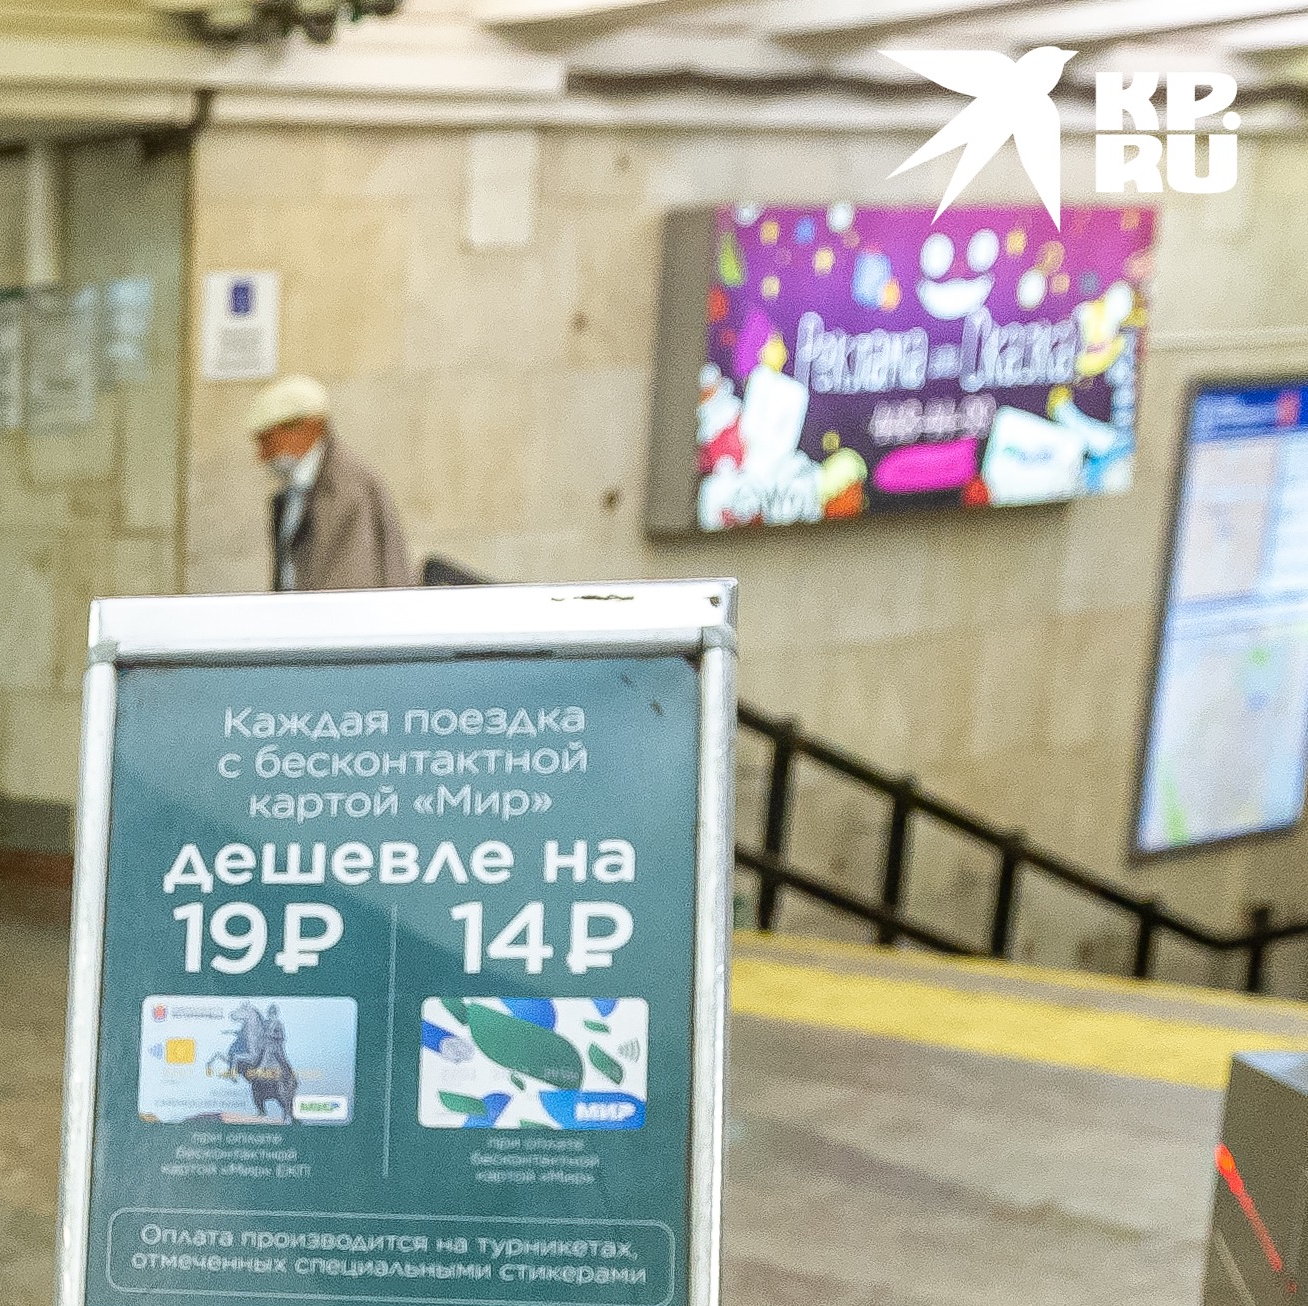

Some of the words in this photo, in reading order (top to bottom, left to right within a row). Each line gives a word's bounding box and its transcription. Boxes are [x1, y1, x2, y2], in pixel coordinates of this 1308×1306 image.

[223, 708, 387, 740] Каждая
[404, 705, 585, 737] поездка
[218, 752, 240, 777] с
[255, 740, 587, 777] бесконтактной
[250, 785, 399, 824] картой
[414, 786, 552, 823] «Мир»
[163, 839, 513, 894] дешевле
[545, 838, 636, 885] на
[173, 902, 344, 975] 19₽
[451, 902, 634, 975] 14₽
[140, 1222, 234, 1249] Оплата
[240, 1228, 429, 1257] производится
[435, 1236, 468, 1256] на
[477, 1236, 639, 1262] турникетах,
[131, 1250, 287, 1275] отмеченных
[294, 1255, 493, 1284] специальными
[498, 1261, 647, 1287] стикерами
